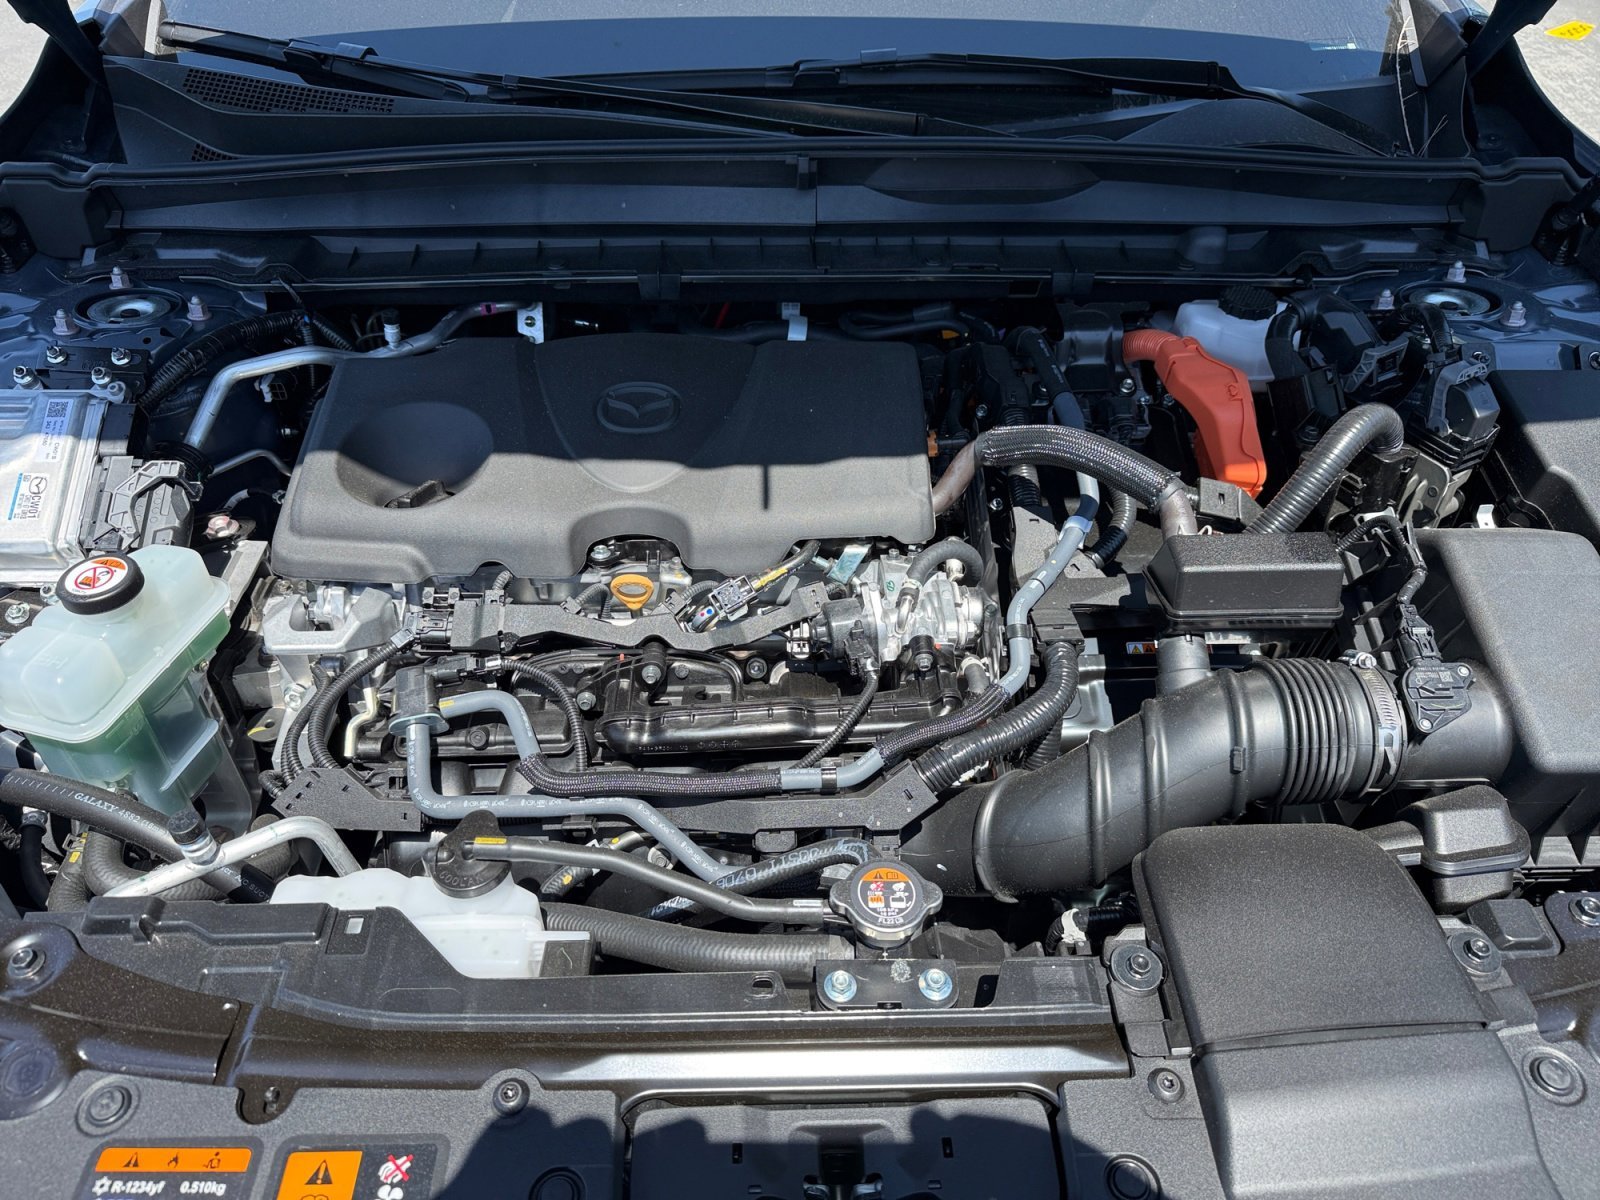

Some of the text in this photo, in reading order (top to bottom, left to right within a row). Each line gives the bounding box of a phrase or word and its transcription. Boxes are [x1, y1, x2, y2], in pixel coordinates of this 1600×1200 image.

[27, 495, 41, 518] CW01
[74, 792, 119, 812] GALAXY
[118, 809, 141, 823] 4882
[110, 1180, 227, 1196] R-1234yf 0.510kg
